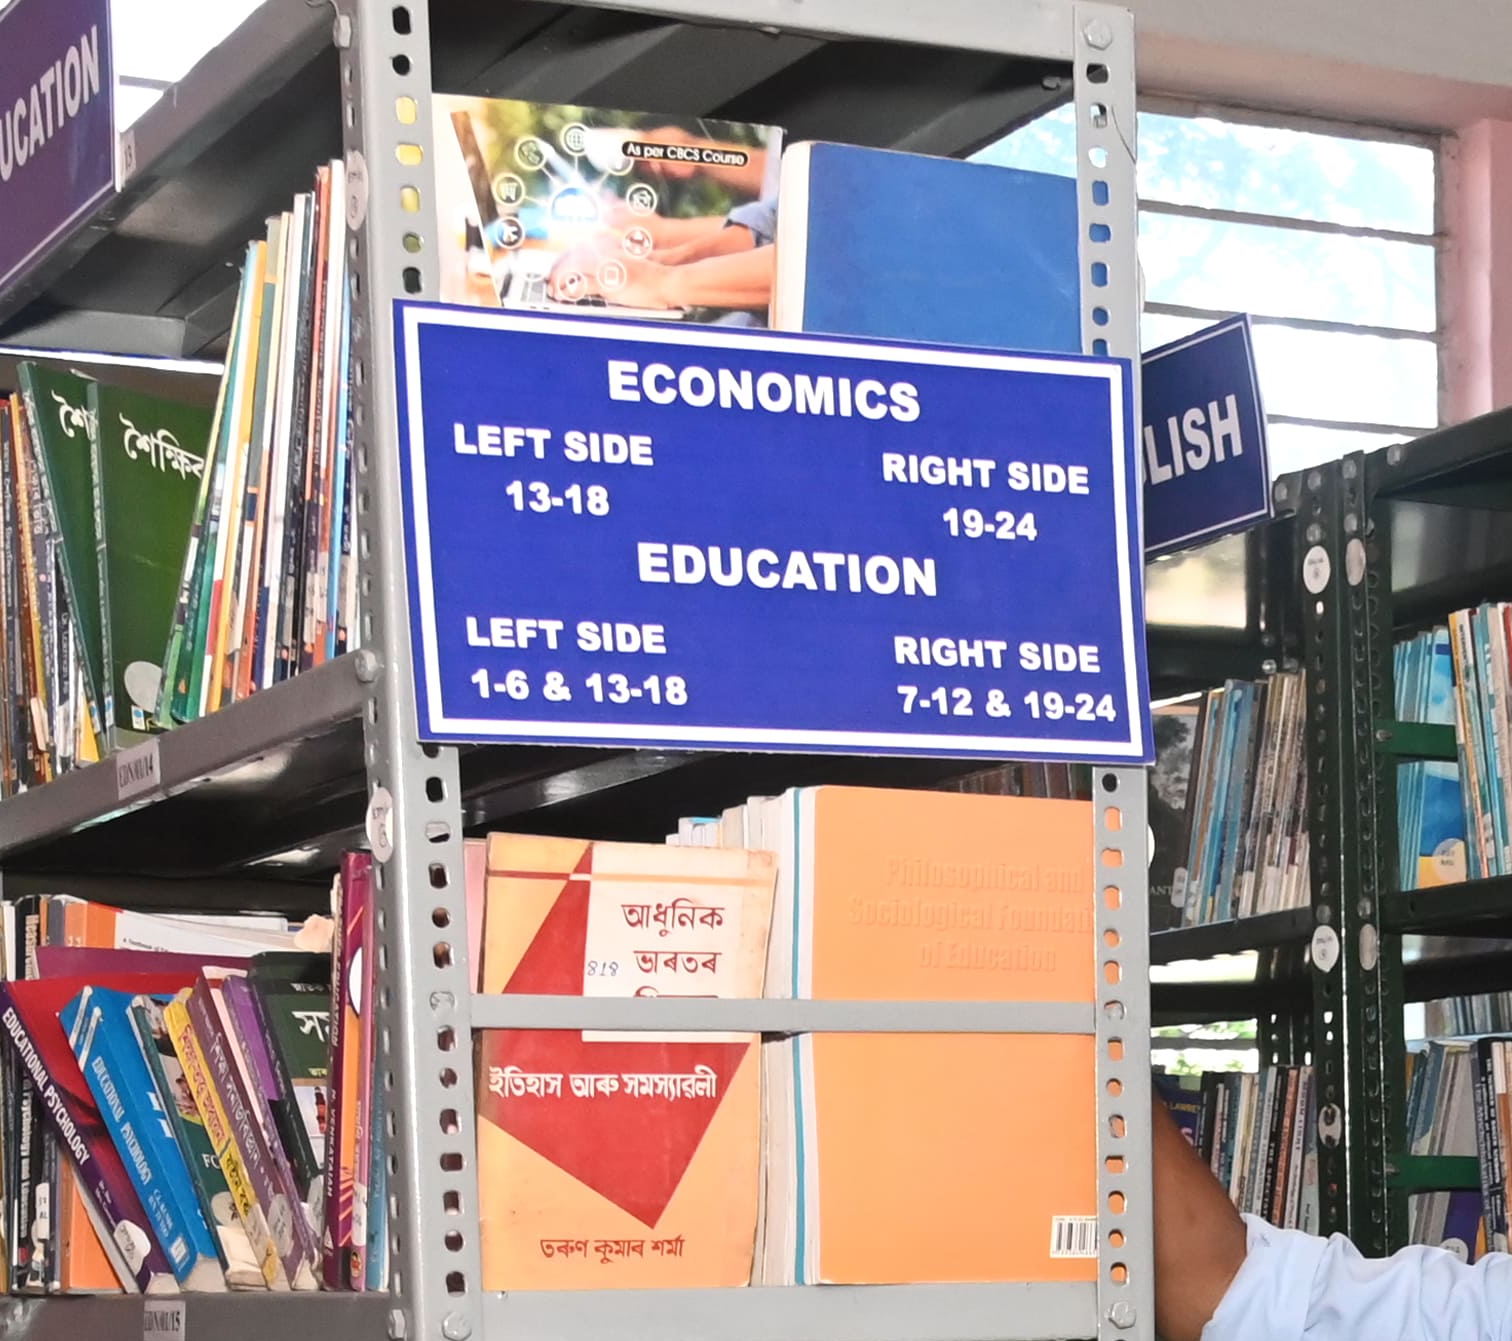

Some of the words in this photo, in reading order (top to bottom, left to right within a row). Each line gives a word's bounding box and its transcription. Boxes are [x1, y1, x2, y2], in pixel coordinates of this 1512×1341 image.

[627, 144, 638, 156] As
[644, 147, 664, 159] per
[667, 148, 699, 161] CBCS
[702, 151, 745, 165] Course
[608, 360, 920, 421] ECONOMICS
[454, 423, 551, 458] LEFT
[565, 431, 653, 465] SIDE
[1143, 394, 1243, 487] LISH
[883, 453, 995, 487] RIGHT
[1008, 462, 1089, 494] SIDE
[506, 481, 609, 515] 13-18
[943, 508, 1037, 540] 19-24
[638, 542, 936, 596] EDUCATION
[467, 617, 563, 649] LEFT
[577, 622, 666, 653] SIDE
[895, 636, 1007, 668] RIGHT
[1019, 642, 1100, 672] SIDE
[472, 669, 529, 699] 1-6
[543, 672, 571, 700] &
[586, 673, 687, 705] 13-18
[898, 686, 973, 715] 7-12
[986, 689, 1011, 717] &
[1024, 691, 1116, 721] 19-24
[621, 898, 725, 937] আধুনিক
[2, 1007, 45, 1090] EDUCATIONAL
[43, 1084, 90, 1166] PSYCHOLOGY
